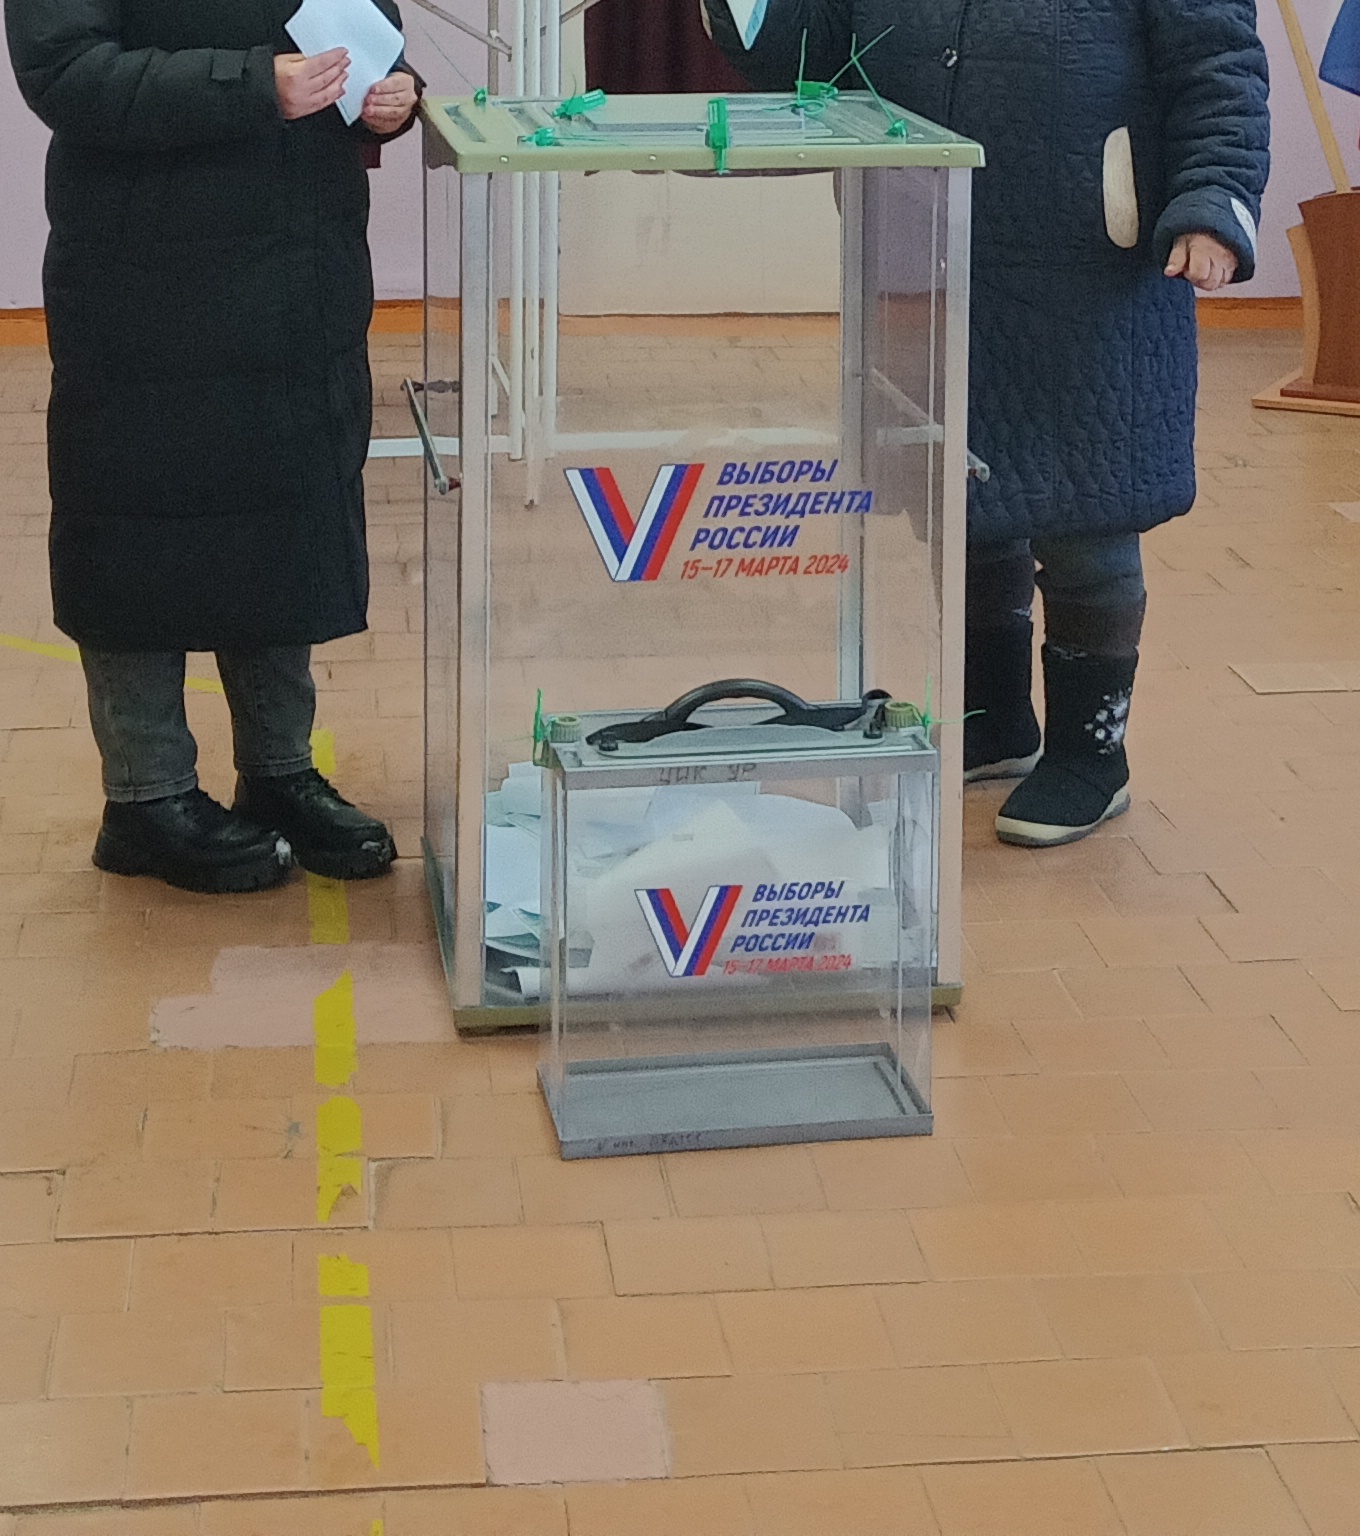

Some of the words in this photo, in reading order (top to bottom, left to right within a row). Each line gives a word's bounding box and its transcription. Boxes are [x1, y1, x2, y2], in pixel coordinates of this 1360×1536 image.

[715, 459, 839, 486] ВЫБОРЫ
[702, 490, 874, 520] ПРЕЗИДЕНТА
[689, 524, 800, 552] РОССИИ
[735, 555, 801, 577] МАРТА
[803, 553, 850, 575] 2024
[751, 880, 845, 903] ВЫБОРЫ
[741, 903, 870, 928] ПРЕЗИДЕНТА
[729, 931, 816, 954] РОССИИ
[766, 955, 814, 973] МАРТА
[815, 953, 853, 971] 2024
